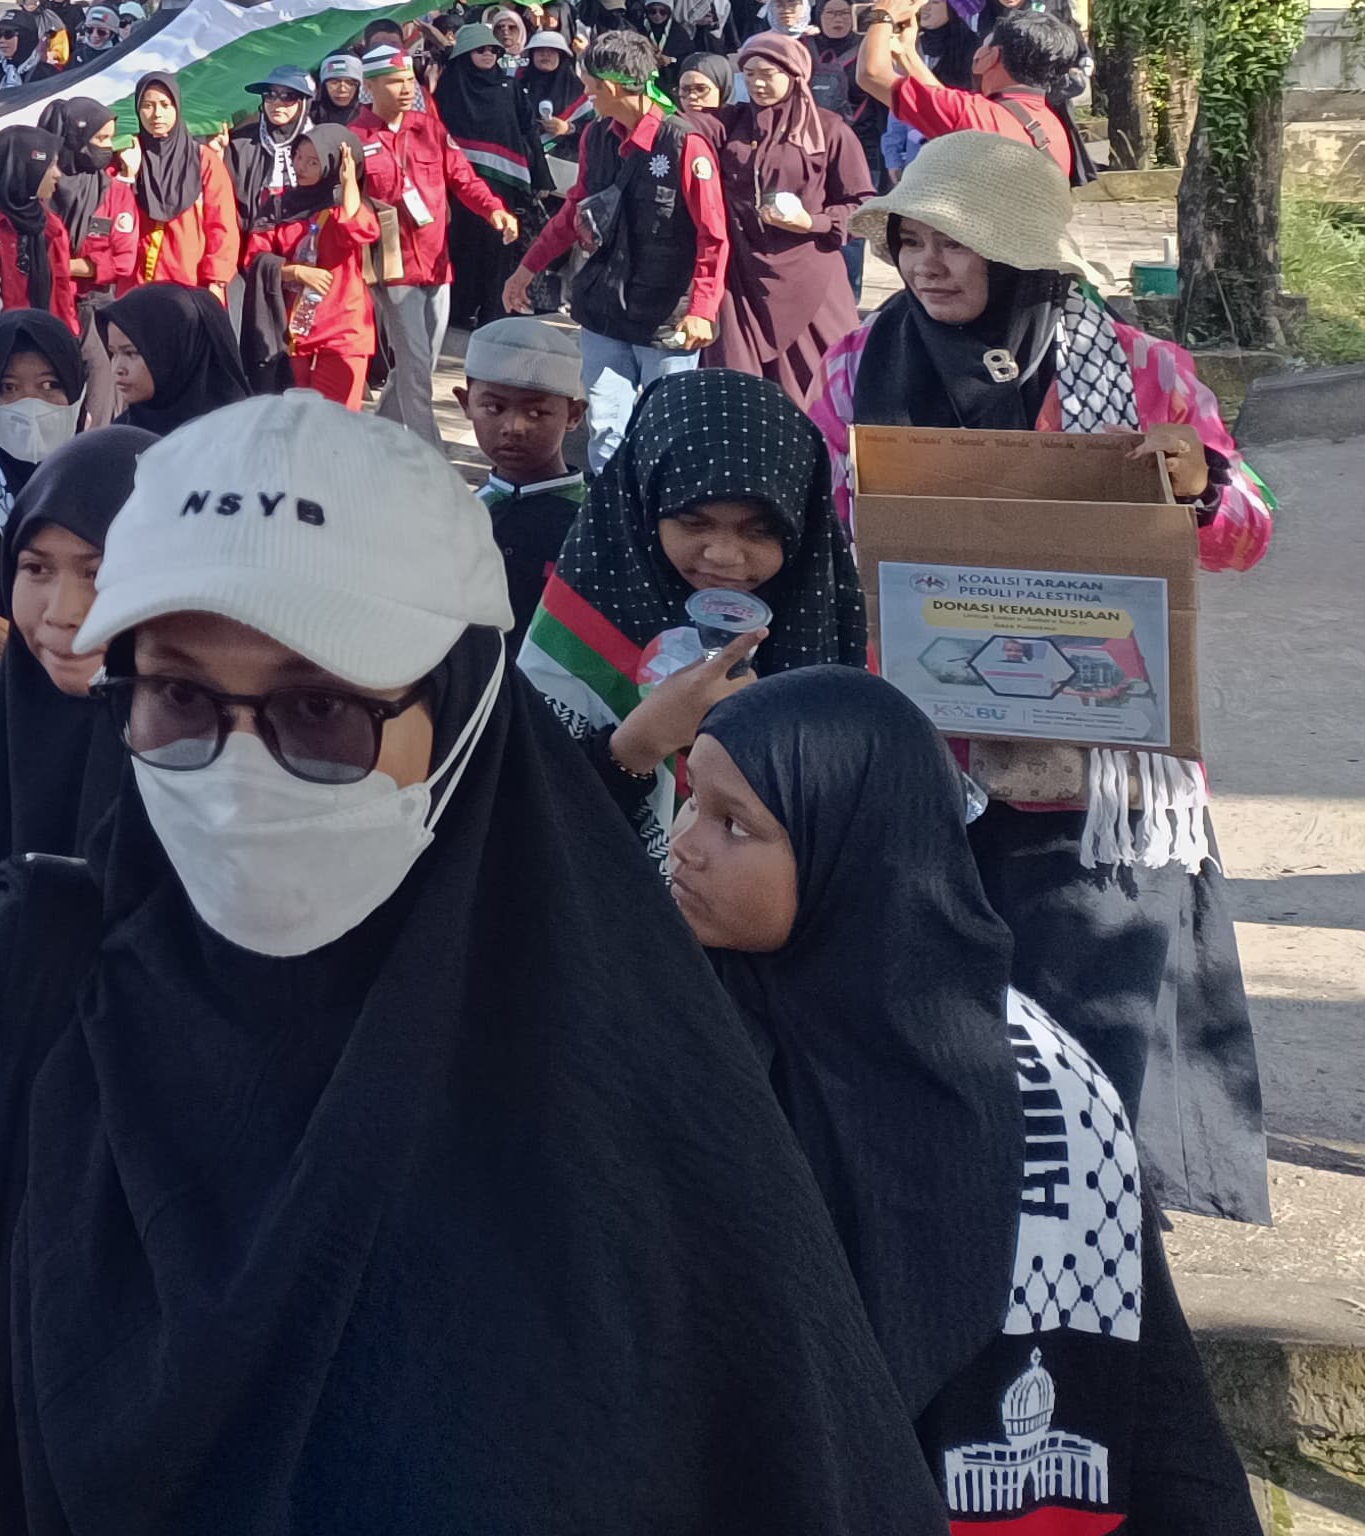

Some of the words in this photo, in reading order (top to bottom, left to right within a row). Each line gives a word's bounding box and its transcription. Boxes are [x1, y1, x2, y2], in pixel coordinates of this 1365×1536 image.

[958, 573, 1019, 586] KOALISI
[1026, 577, 1103, 591] TARAKAN
[959, 586, 1011, 598] PEDULI
[1016, 590, 1102, 603] PALESTINA
[933, 600, 994, 613] DONASI
[999, 604, 1120, 622] KEMANUSIAAN
